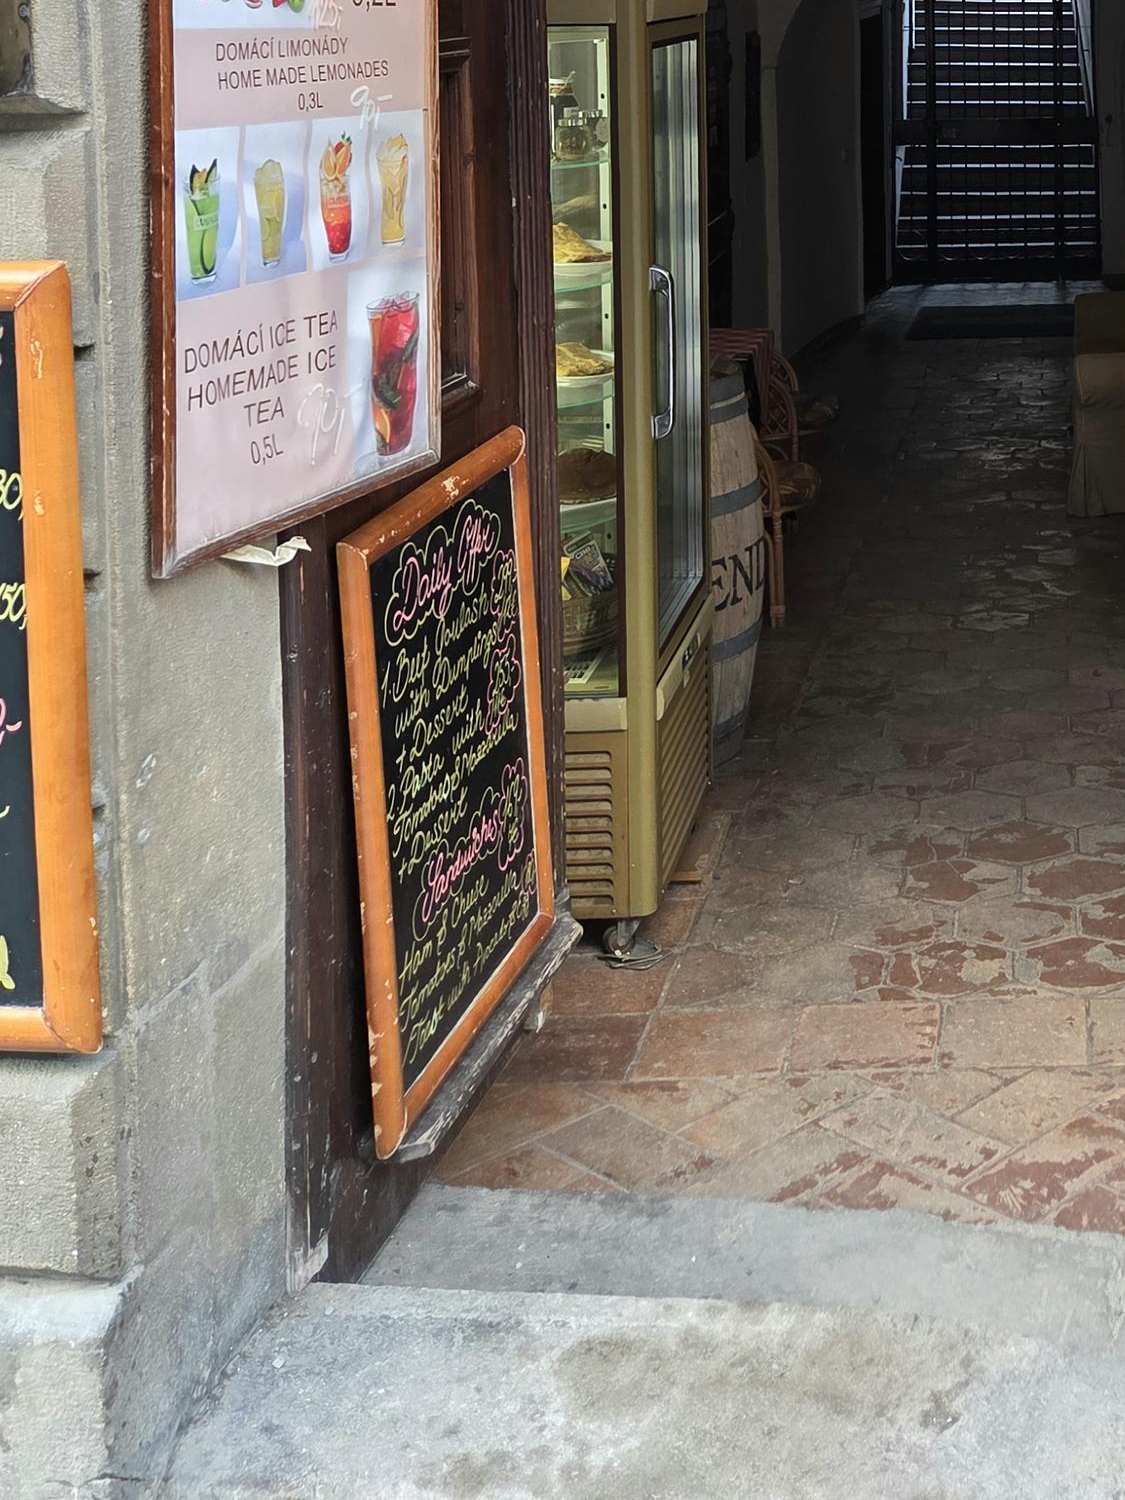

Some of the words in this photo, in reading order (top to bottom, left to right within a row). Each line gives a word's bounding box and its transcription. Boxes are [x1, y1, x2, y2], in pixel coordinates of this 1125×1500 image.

[215, 37, 274, 62] DOMÁCÍ
[277, 35, 348, 58] LIMONÁDY
[218, 71, 262, 90] HOME
[266, 66, 307, 86] MADE
[310, 60, 389, 83] LEMONADES
[298, 92, 324, 111] 0,3L
[185, 322, 264, 374] DOMÁCÍ
[269, 319, 296, 350] ICE
[303, 309, 338, 340] TEA
[187, 355, 299, 411] HOMEMADE
[308, 345, 337, 377] ICE
[243, 397, 285, 428] TEA
[250, 439, 284, 465] 0,5L
[393, 547, 453, 631] Daily
[457, 514, 495, 584] Offer
[436, 583, 489, 656] Goulash
[395, 687, 431, 738] with
[432, 621, 497, 700] Dumplings
[400, 754, 444, 813] Pasta
[452, 698, 485, 755] with
[410, 684, 468, 762] Dessert
[393, 773, 450, 858] Tomatoes
[408, 786, 468, 875] Dessert
[421, 810, 498, 923] Sandwiches
[399, 940, 433, 997] Ham
[452, 875, 489, 928] Cheese
[402, 995, 444, 1068] Toast
